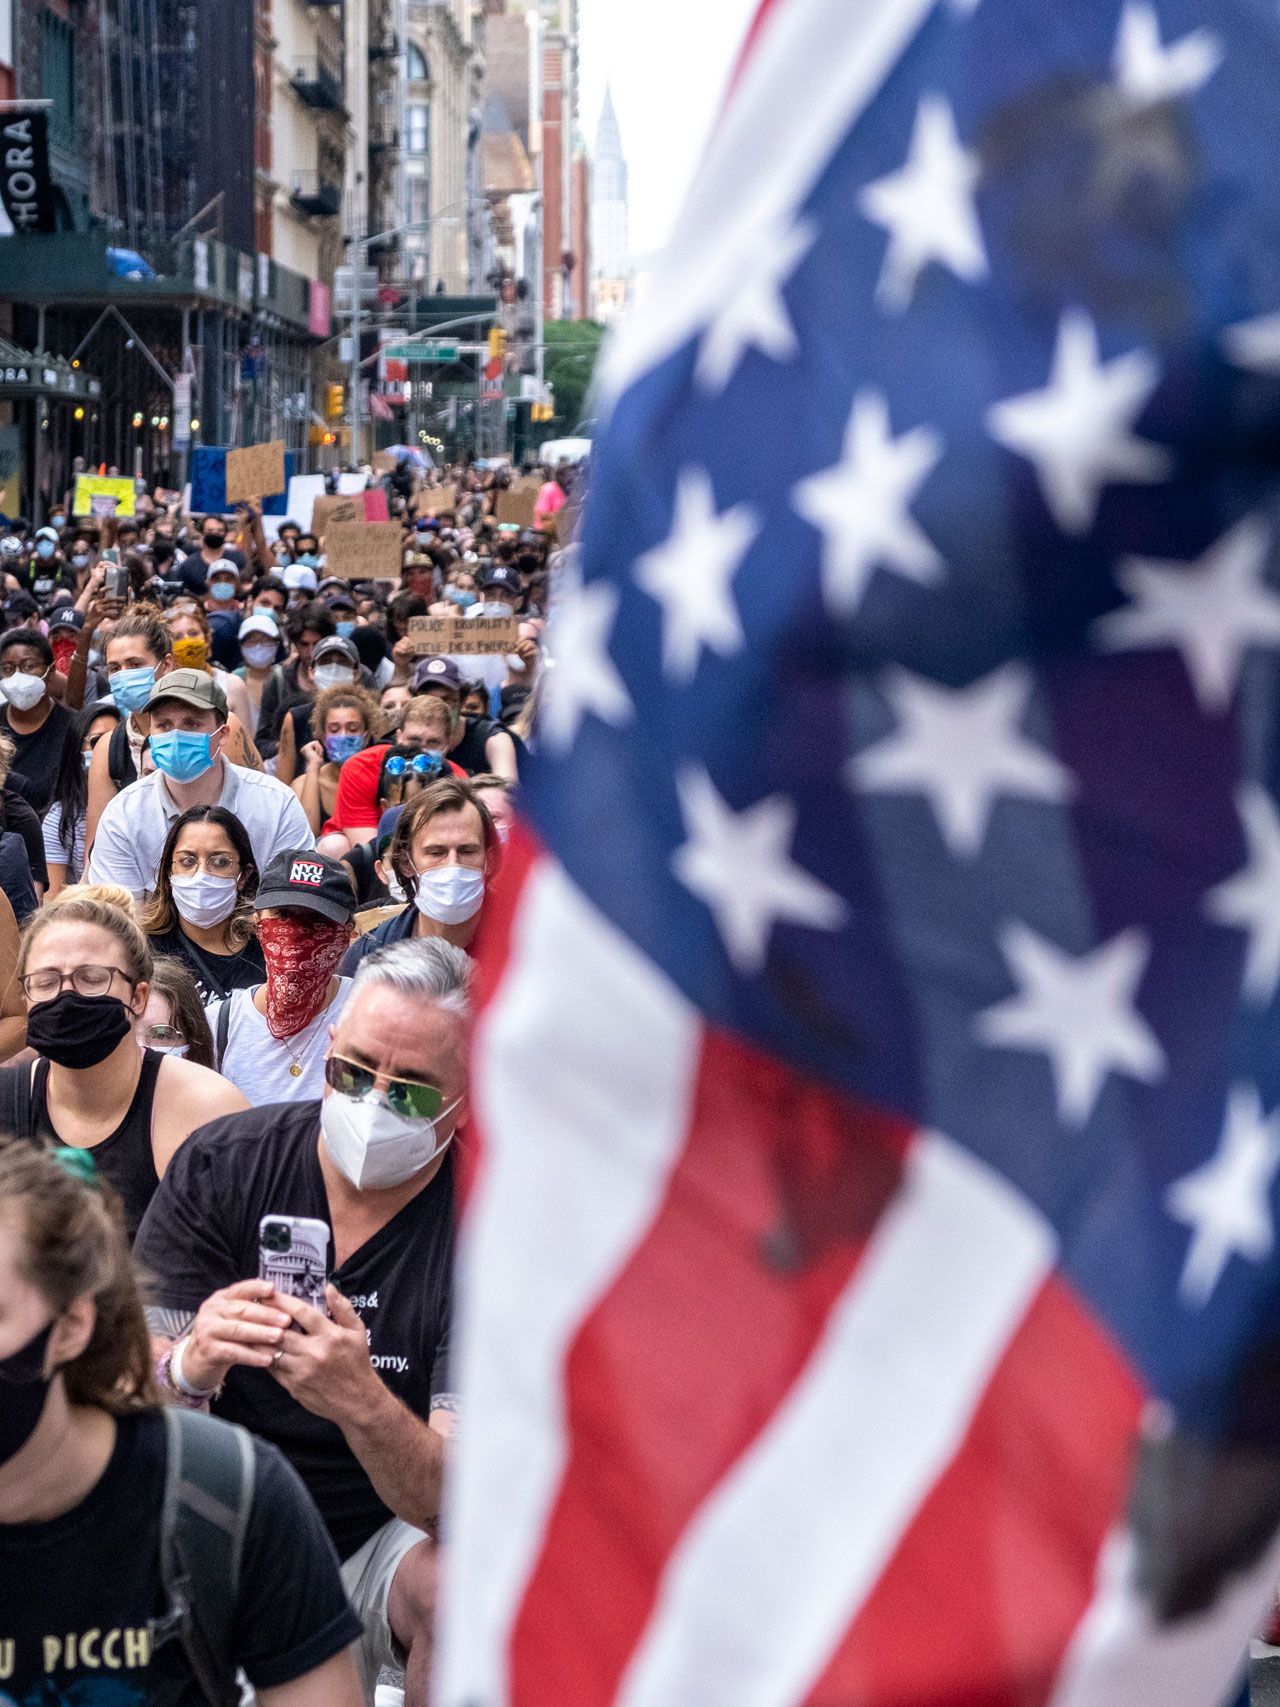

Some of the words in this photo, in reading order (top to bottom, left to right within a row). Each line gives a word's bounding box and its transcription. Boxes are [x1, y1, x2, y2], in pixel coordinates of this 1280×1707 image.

[3, 118, 39, 223] HORA
[291, 863, 324, 876] NYU
[289, 872, 321, 884] NYC
